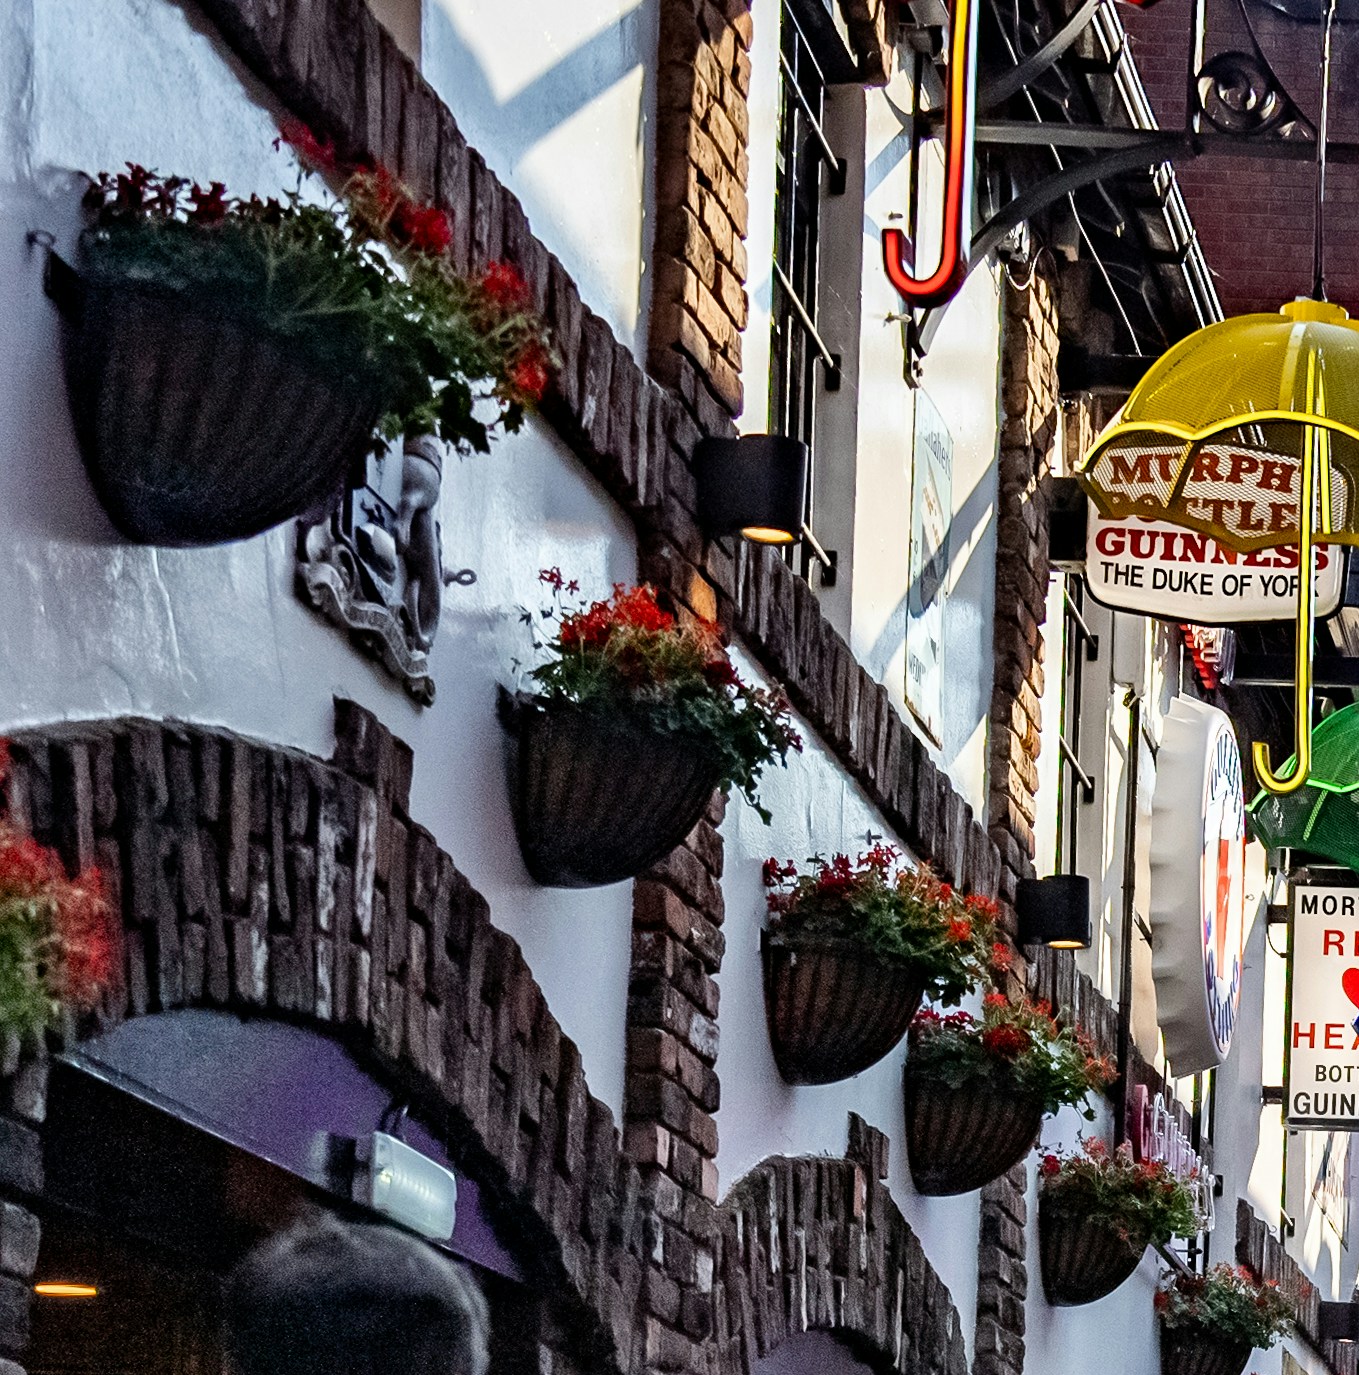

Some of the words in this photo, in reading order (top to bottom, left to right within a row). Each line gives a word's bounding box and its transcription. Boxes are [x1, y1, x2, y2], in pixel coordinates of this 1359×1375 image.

[1101, 562, 1143, 588] THE
[1153, 568, 1213, 595] DUKE
[1222, 575, 1252, 596] OF
